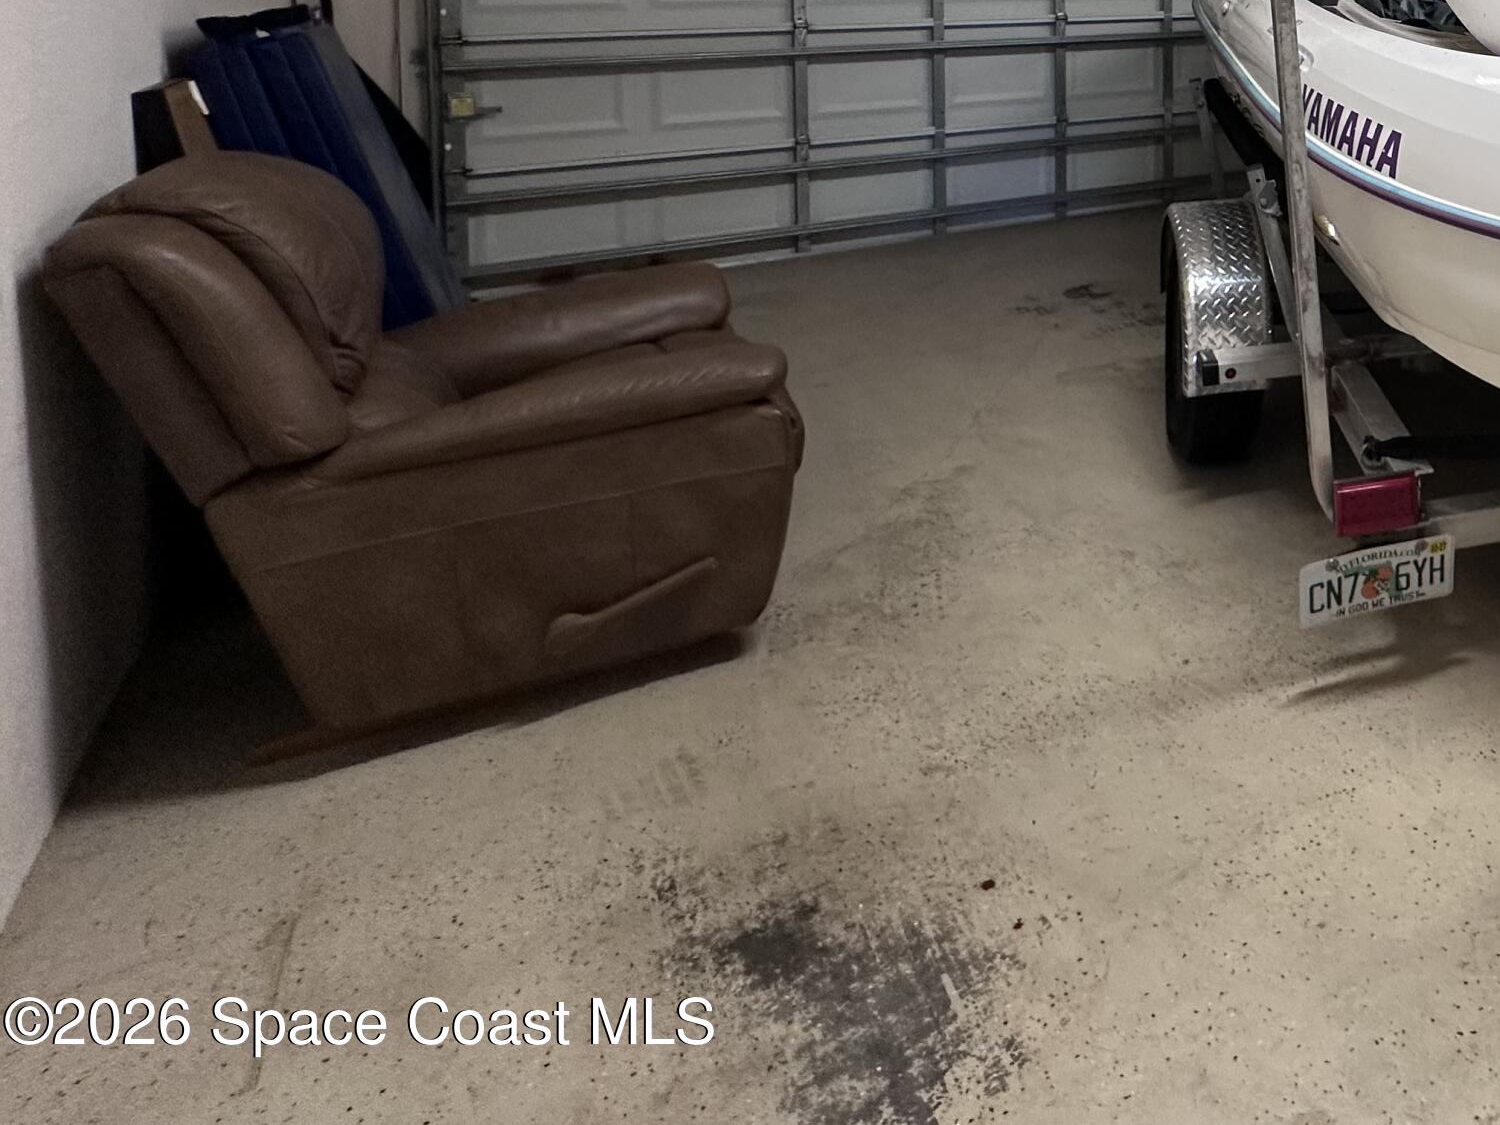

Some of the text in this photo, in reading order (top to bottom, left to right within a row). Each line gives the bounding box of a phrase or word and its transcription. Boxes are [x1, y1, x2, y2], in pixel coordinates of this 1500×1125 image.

[1303, 83, 1402, 179] YAMAHA
[1309, 554, 1445, 614] CN7 6YH
